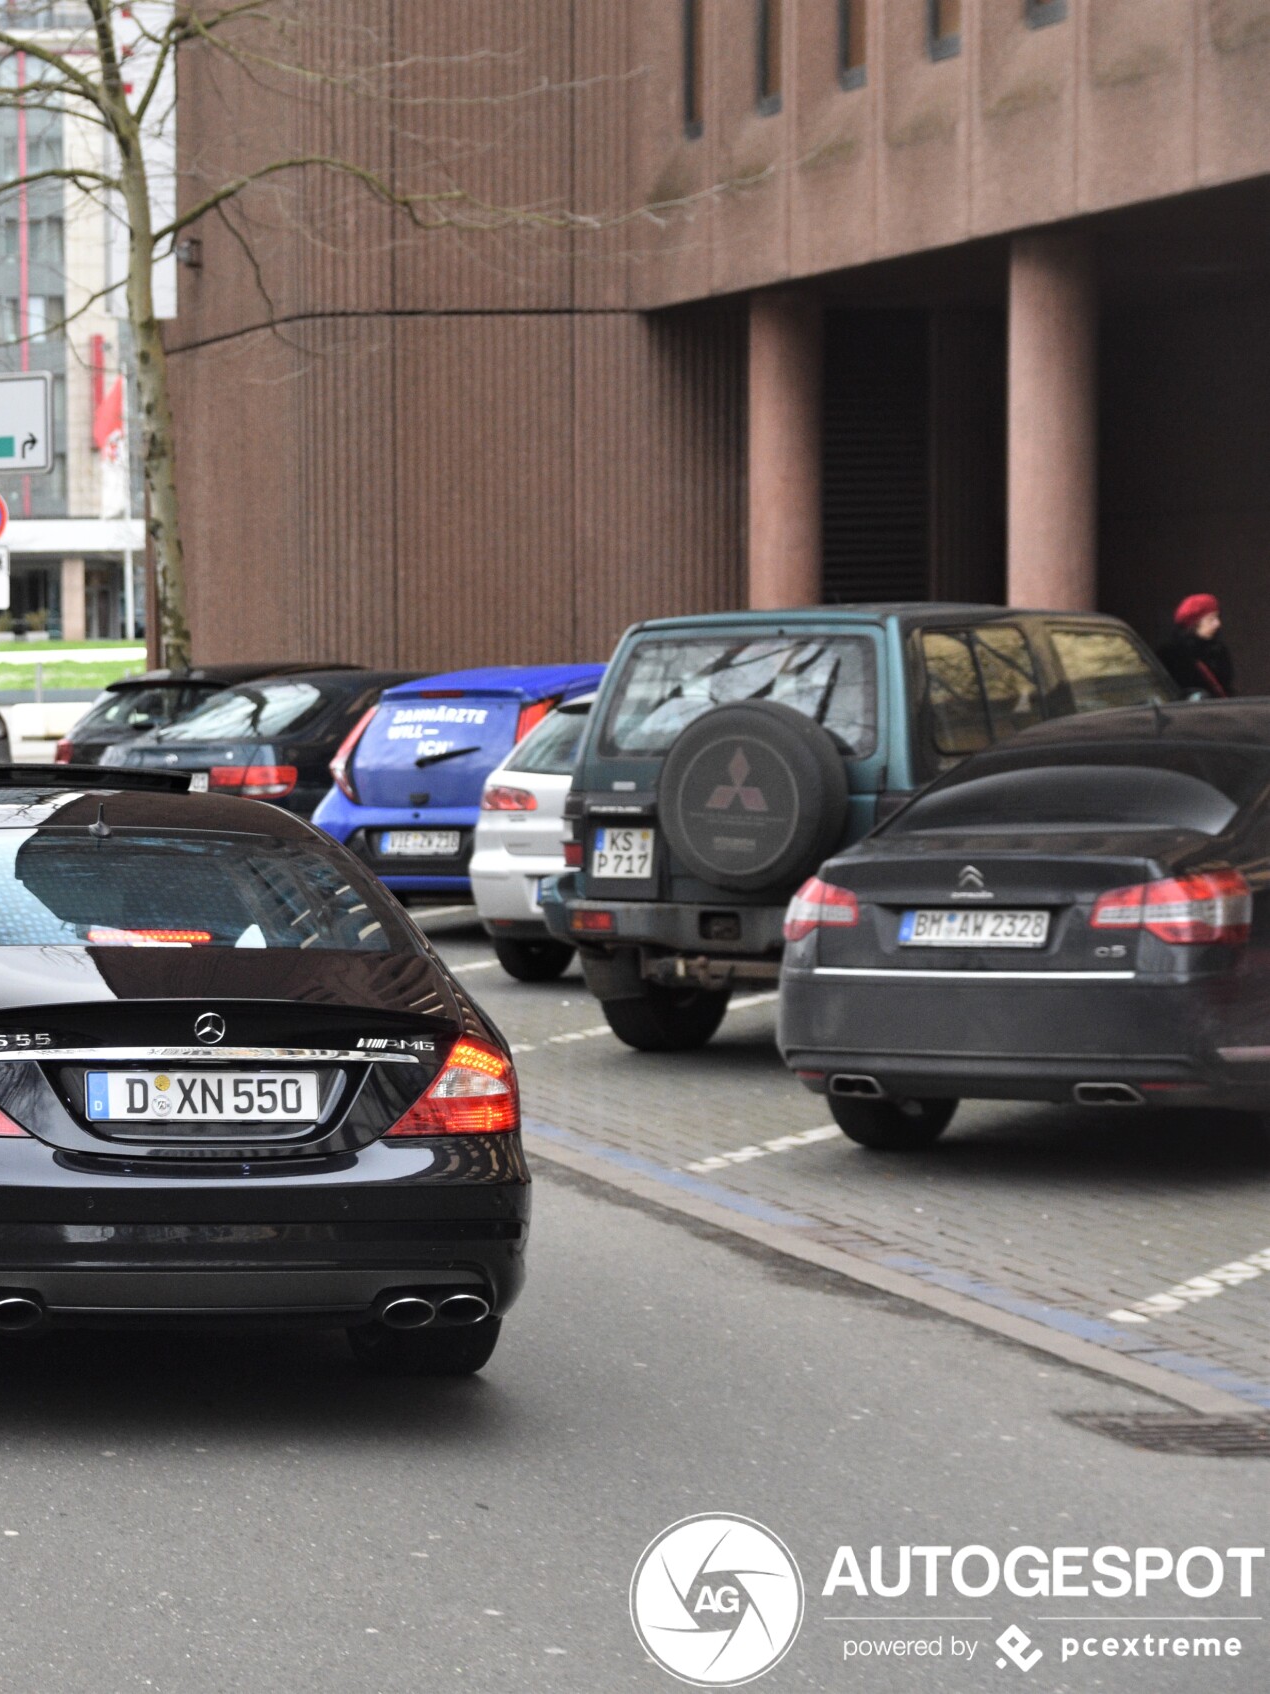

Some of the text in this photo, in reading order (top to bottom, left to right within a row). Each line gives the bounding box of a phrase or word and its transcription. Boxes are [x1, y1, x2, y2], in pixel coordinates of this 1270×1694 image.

[610, 832, 633, 851] KS
[598, 853, 649, 873] P 717
[914, 914, 1044, 937] BM AW 2328
[16, 1033, 51, 1046] 55
[126, 1078, 302, 1114] D XN 550
